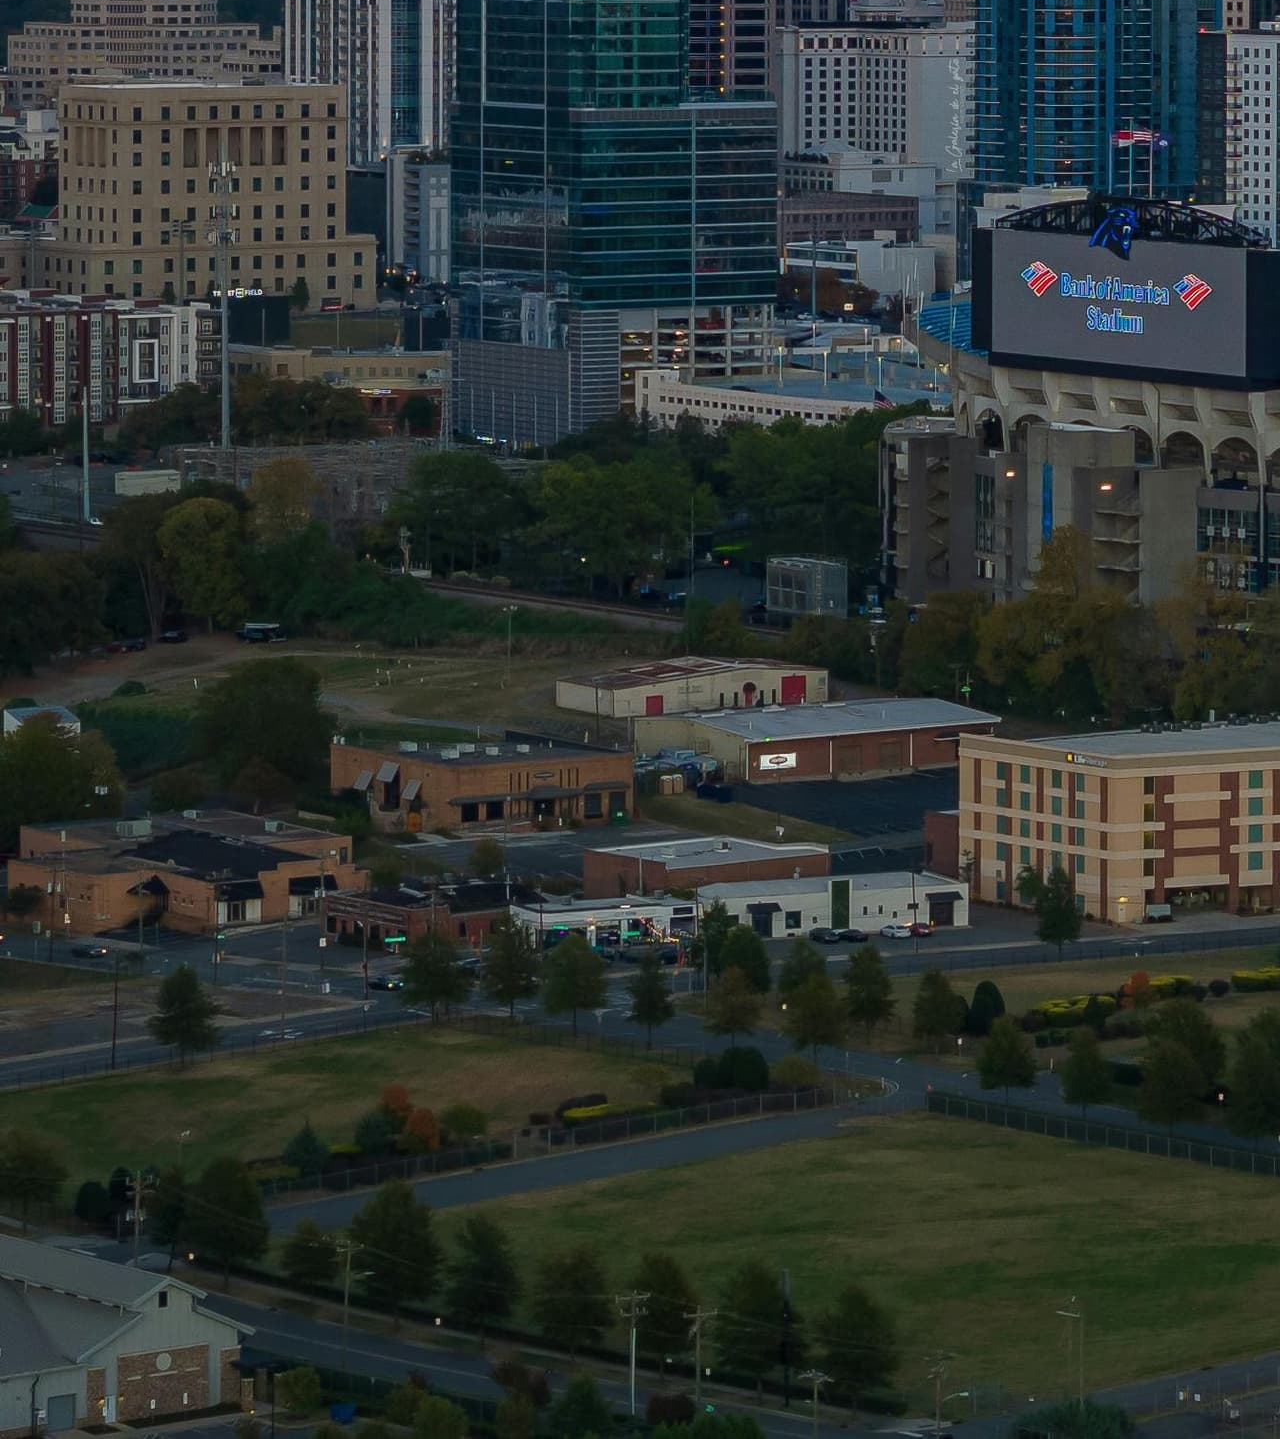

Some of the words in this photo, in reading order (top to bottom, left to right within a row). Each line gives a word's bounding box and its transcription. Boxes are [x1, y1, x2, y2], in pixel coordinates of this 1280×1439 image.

[1060, 272, 1096, 299] Bank
[1096, 275, 1112, 300] of
[1112, 277, 1170, 306] America
[1086, 305, 1144, 334] Stadium
